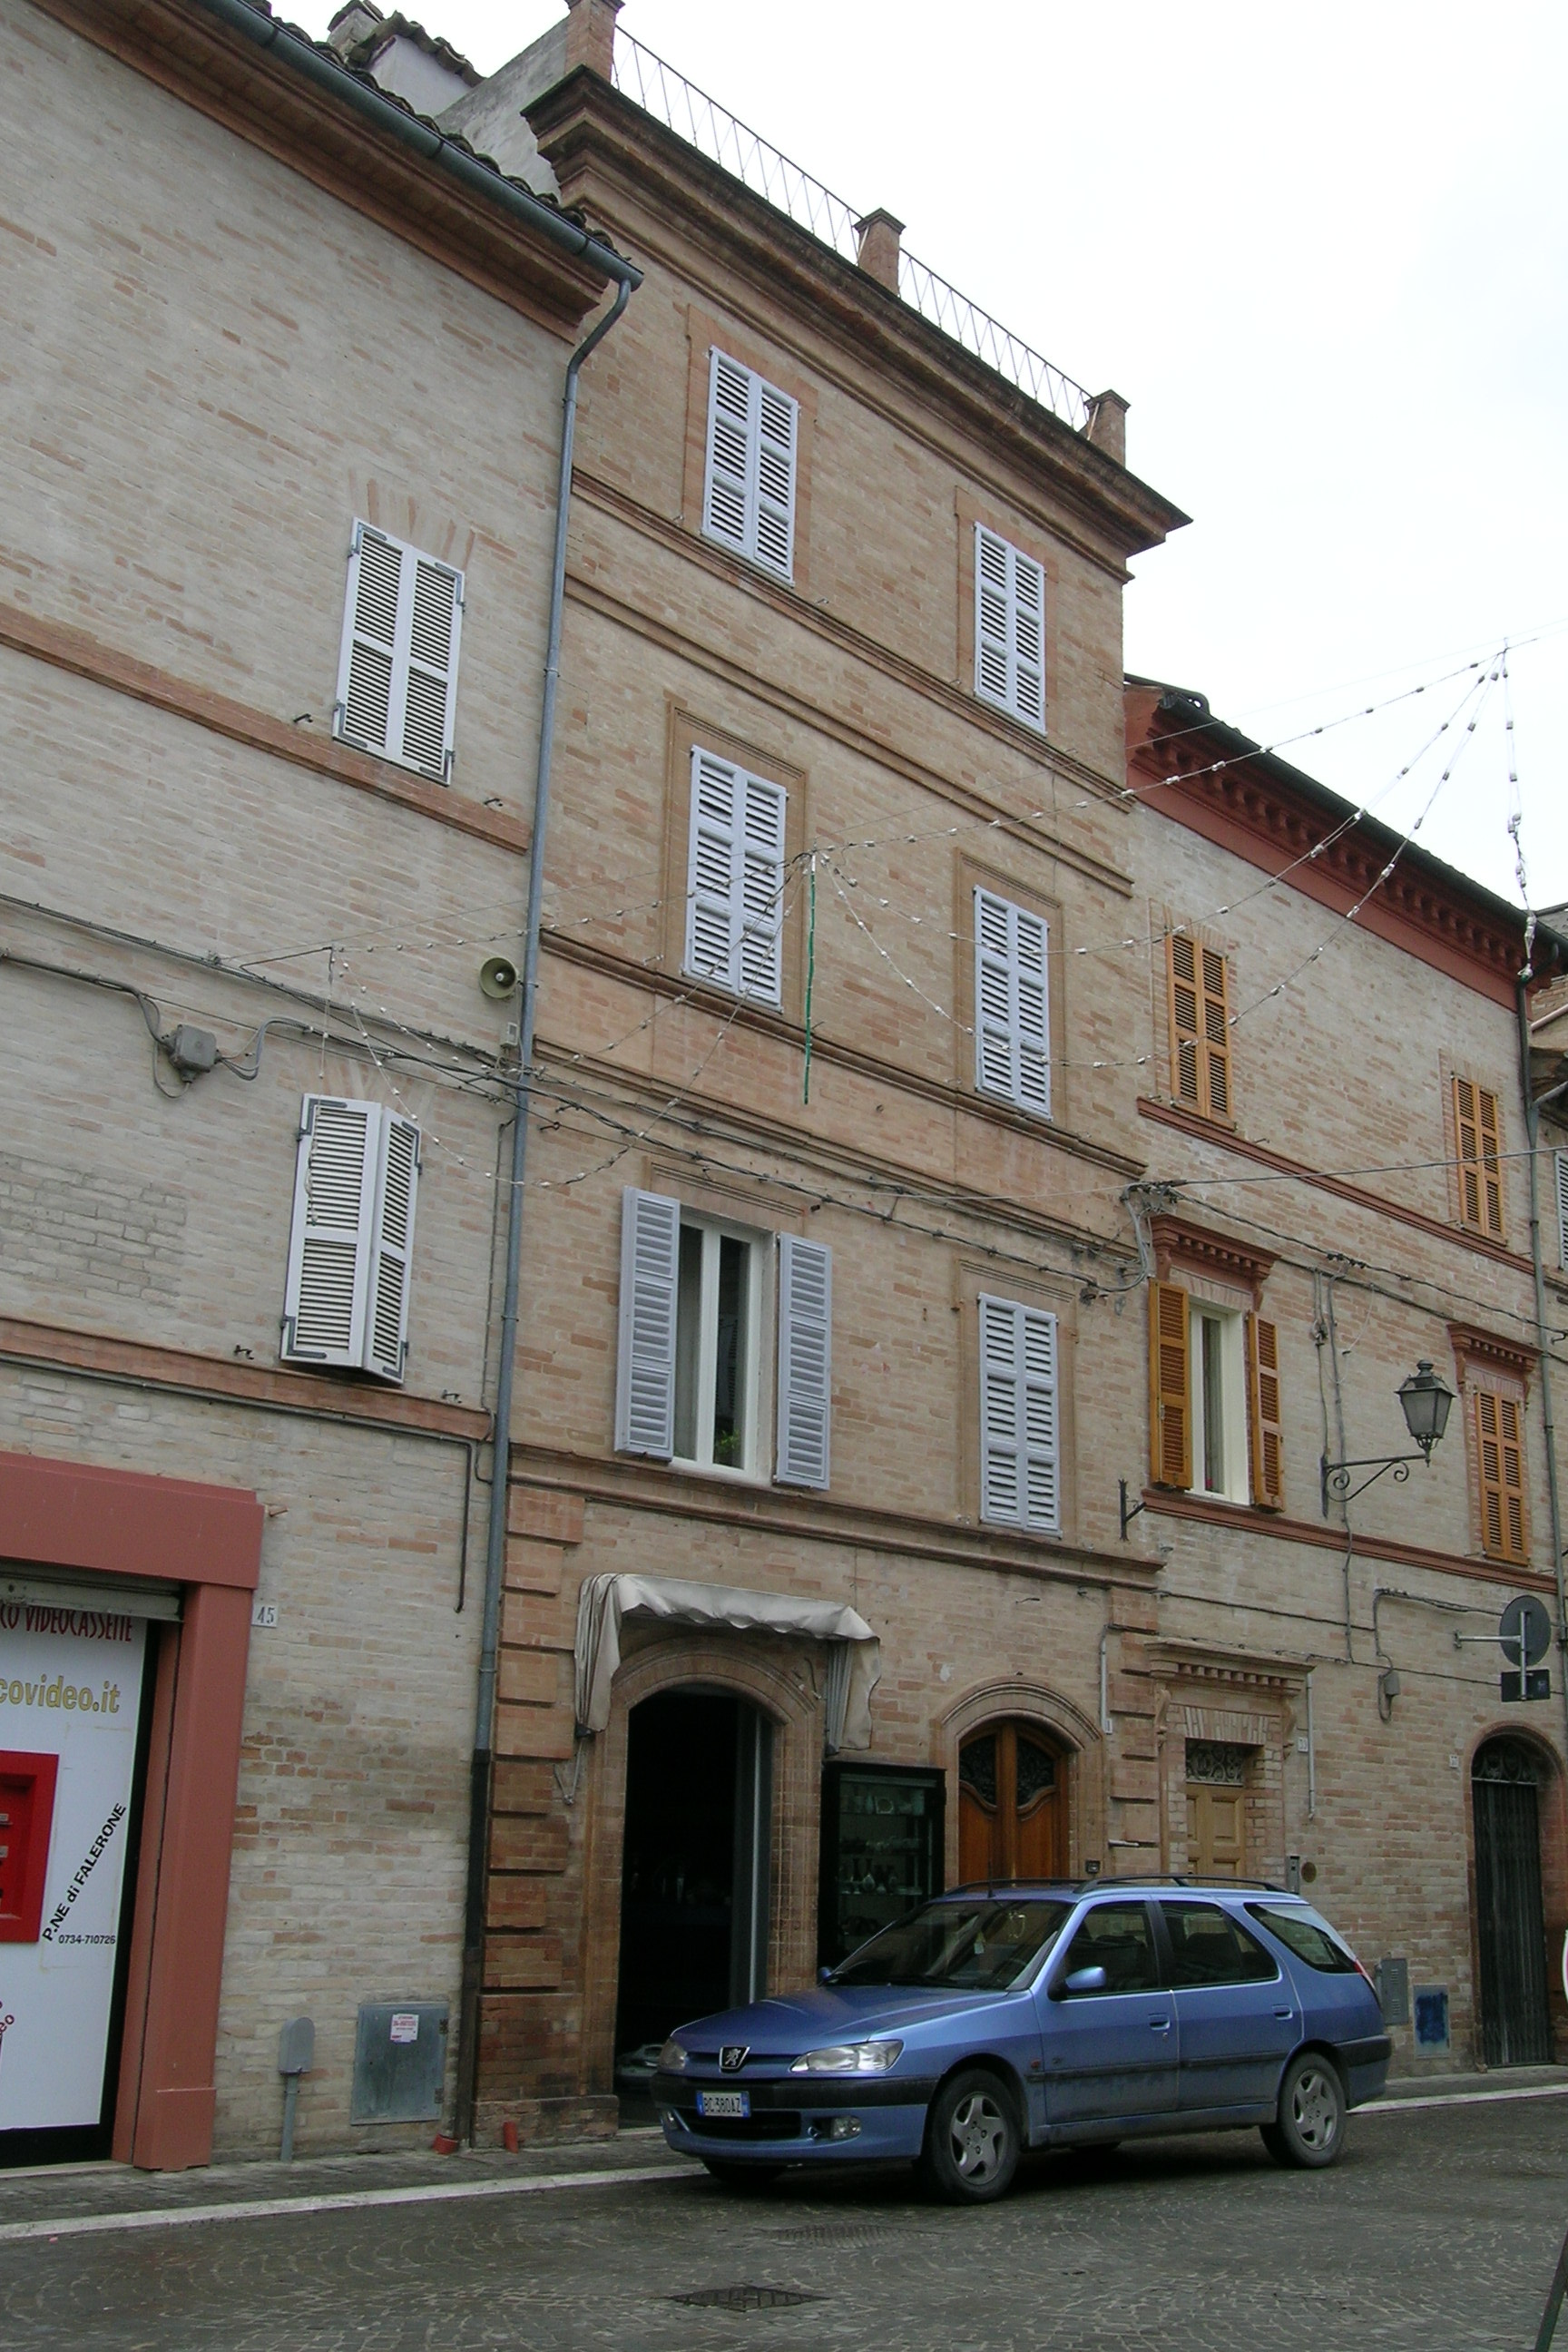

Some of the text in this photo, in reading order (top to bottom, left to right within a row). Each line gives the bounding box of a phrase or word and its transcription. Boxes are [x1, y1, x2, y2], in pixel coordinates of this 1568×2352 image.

[257, 1606, 275, 1624] 45
[42, 1802, 127, 1942] P.NE di FALERONE
[58, 1934, 116, 1945] 0734-710726
